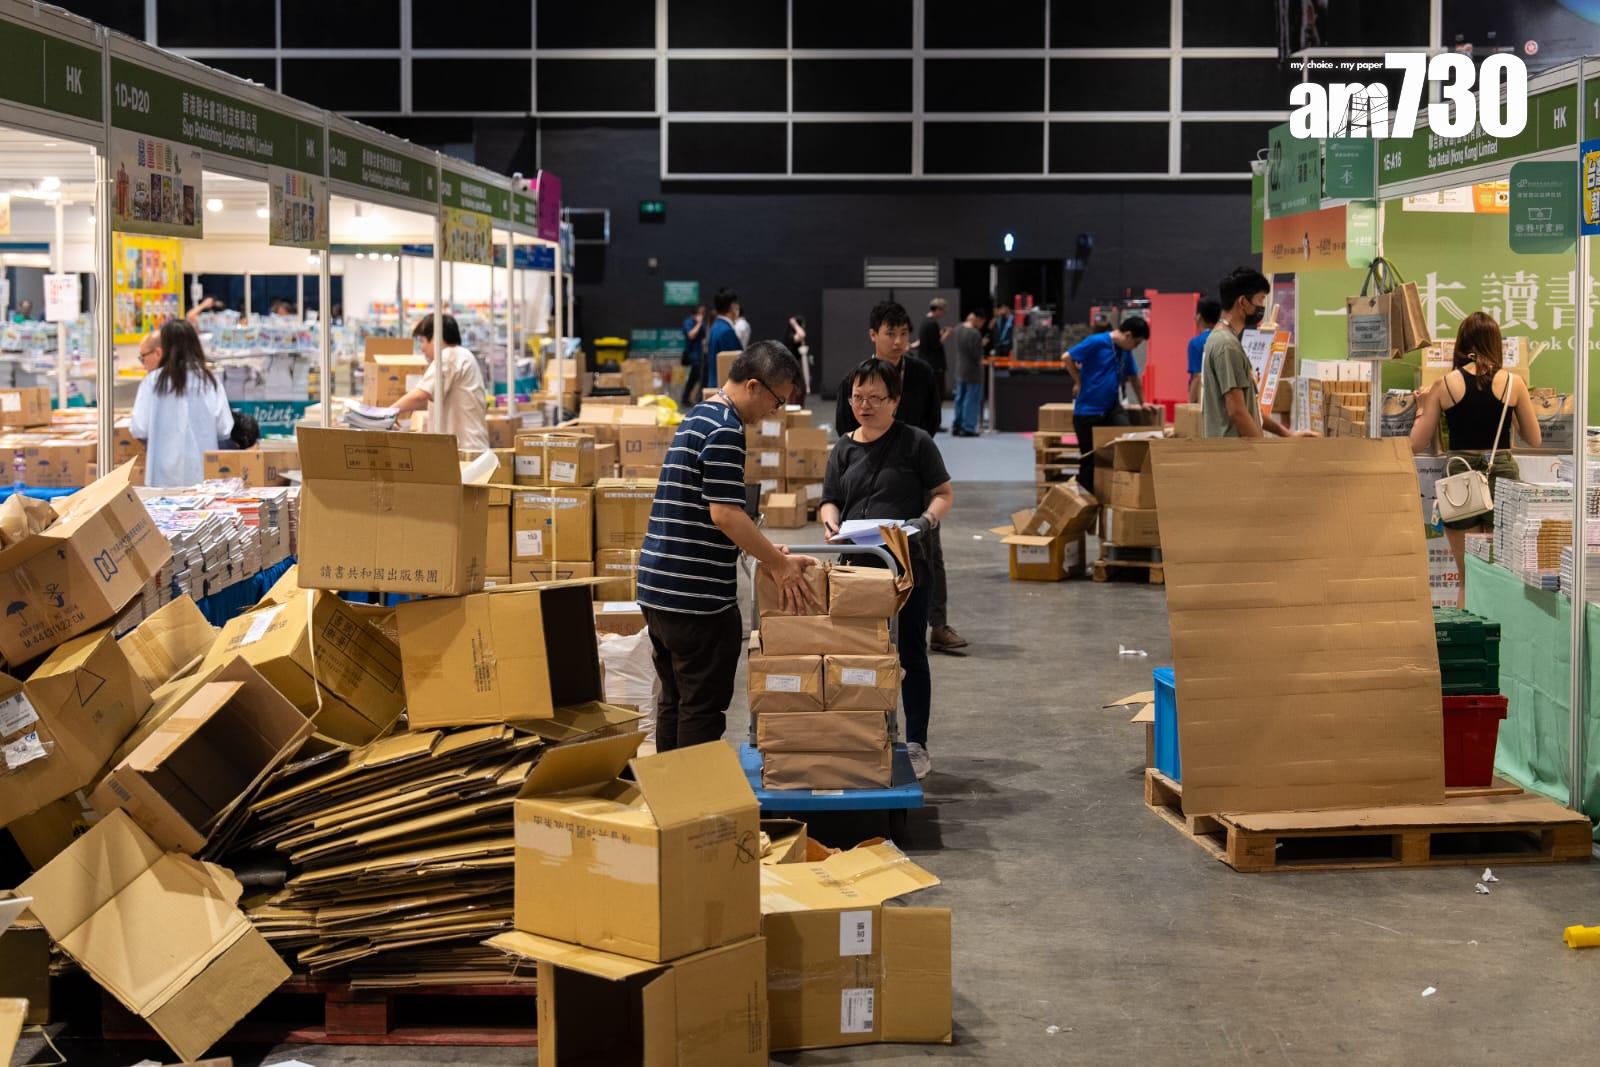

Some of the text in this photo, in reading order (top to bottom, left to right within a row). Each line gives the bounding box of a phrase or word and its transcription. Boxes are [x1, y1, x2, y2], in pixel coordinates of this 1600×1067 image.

[66, 65, 83, 96] HK
[115, 81, 150, 115] 1D-D20
[182, 118, 194, 140] Sup
[1553, 105, 1567, 130] HK
[1428, 154, 1437, 169] Sup
[1479, 138, 1498, 157] Limited
[320, 565, 438, 584] 讀書共和國出版集團
